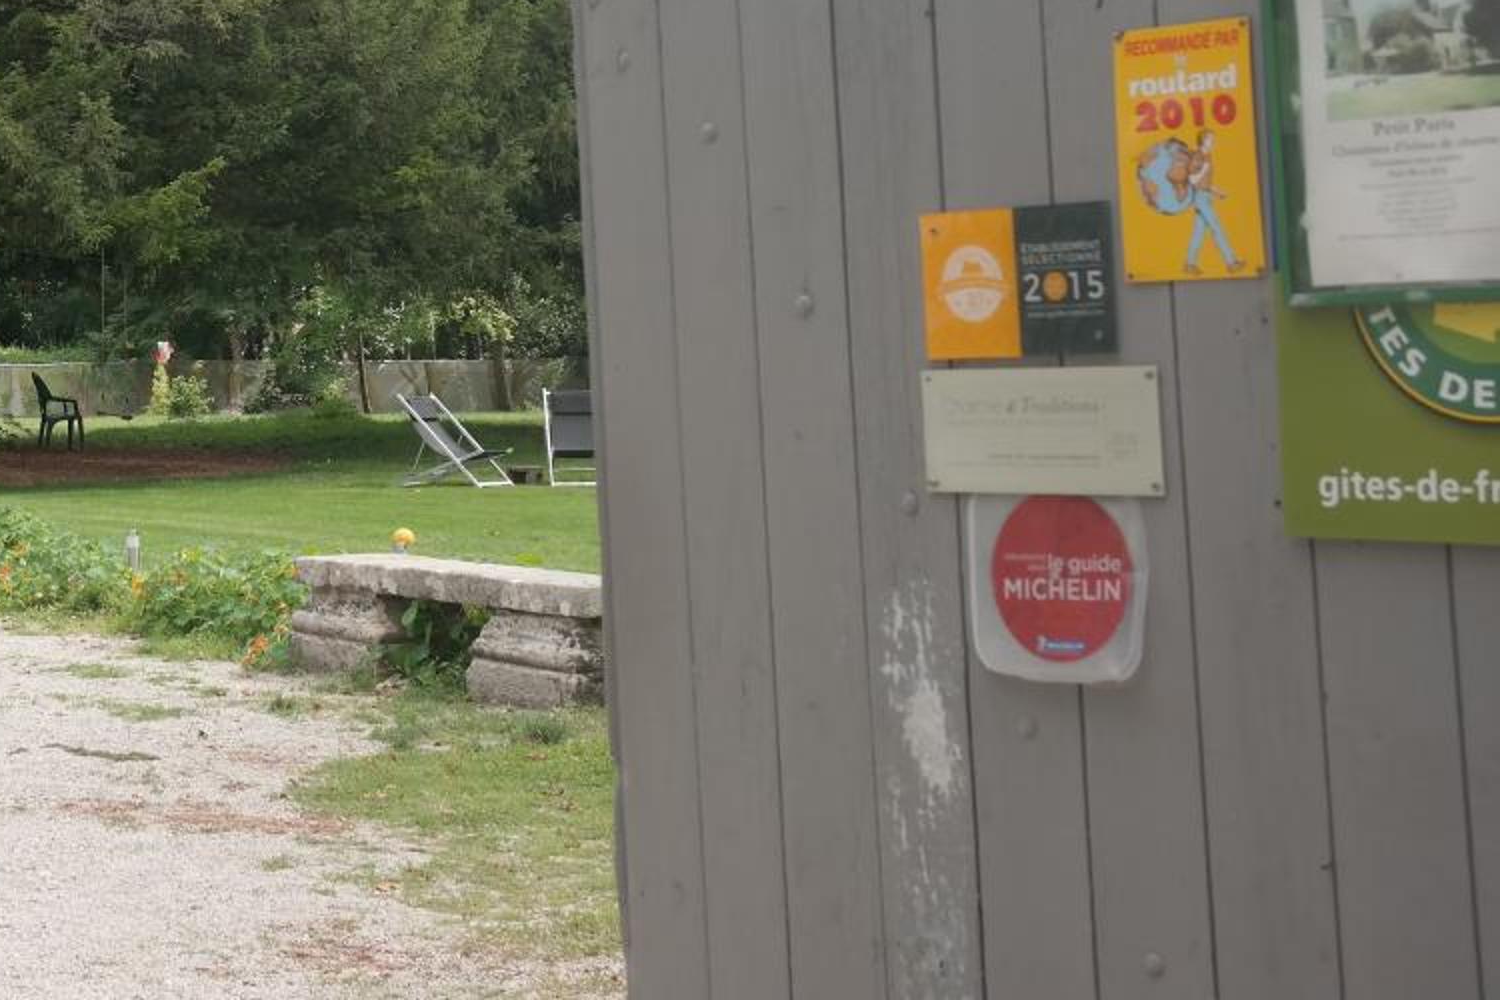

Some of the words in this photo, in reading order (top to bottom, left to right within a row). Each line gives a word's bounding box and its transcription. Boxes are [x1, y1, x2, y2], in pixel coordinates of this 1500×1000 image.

[1129, 61, 1237, 98] routard
[1135, 94, 1237, 133] 2010
[1023, 269, 1104, 302] 2015
[1438, 370, 1496, 409] DE
[1047, 553, 1063, 571] le
[1067, 553, 1122, 575] guide
[1003, 577, 1122, 601] MICHELIN
